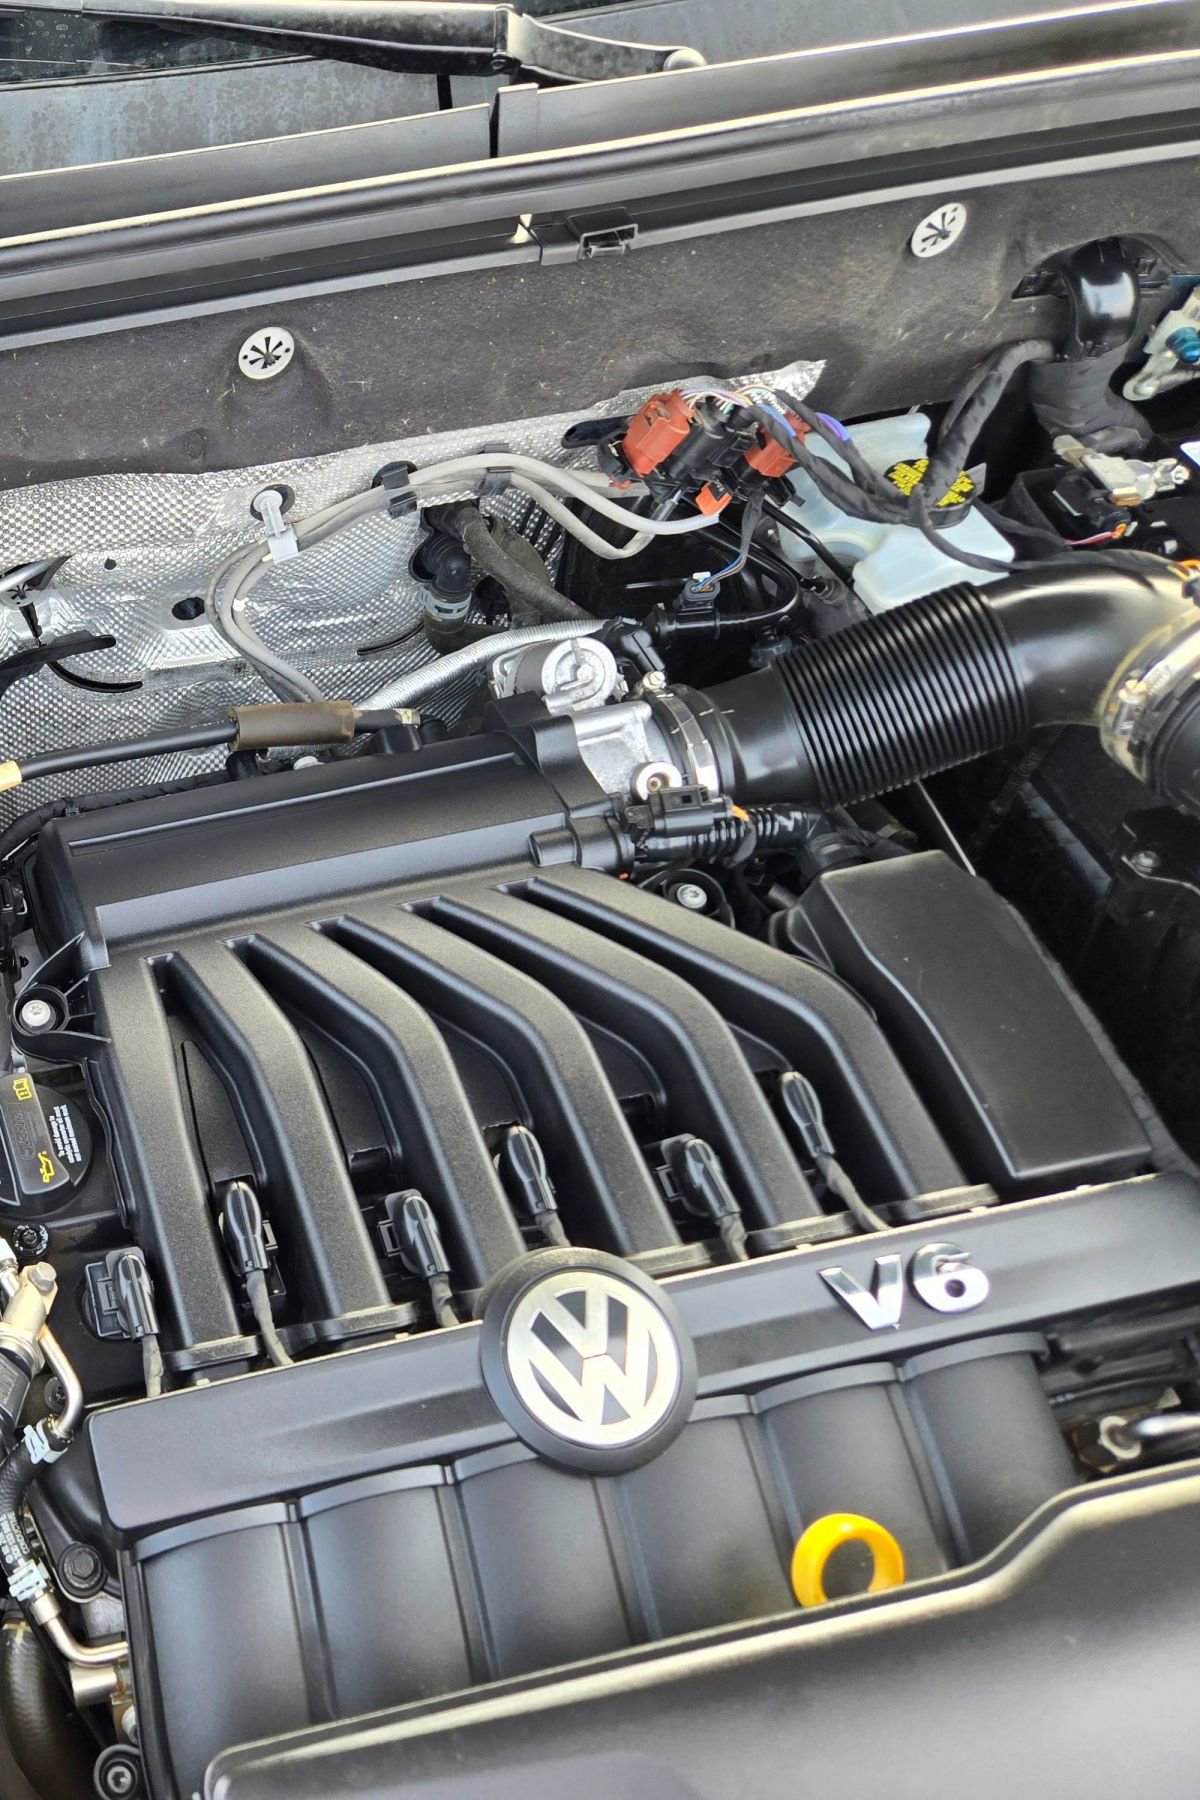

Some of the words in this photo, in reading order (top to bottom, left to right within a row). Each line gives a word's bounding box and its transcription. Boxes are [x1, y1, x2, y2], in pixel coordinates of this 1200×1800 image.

[818, 1242, 990, 1330] V6
[506, 1271, 679, 1448] VW
[7, 1511, 30, 1554] CONDUCTIVE
